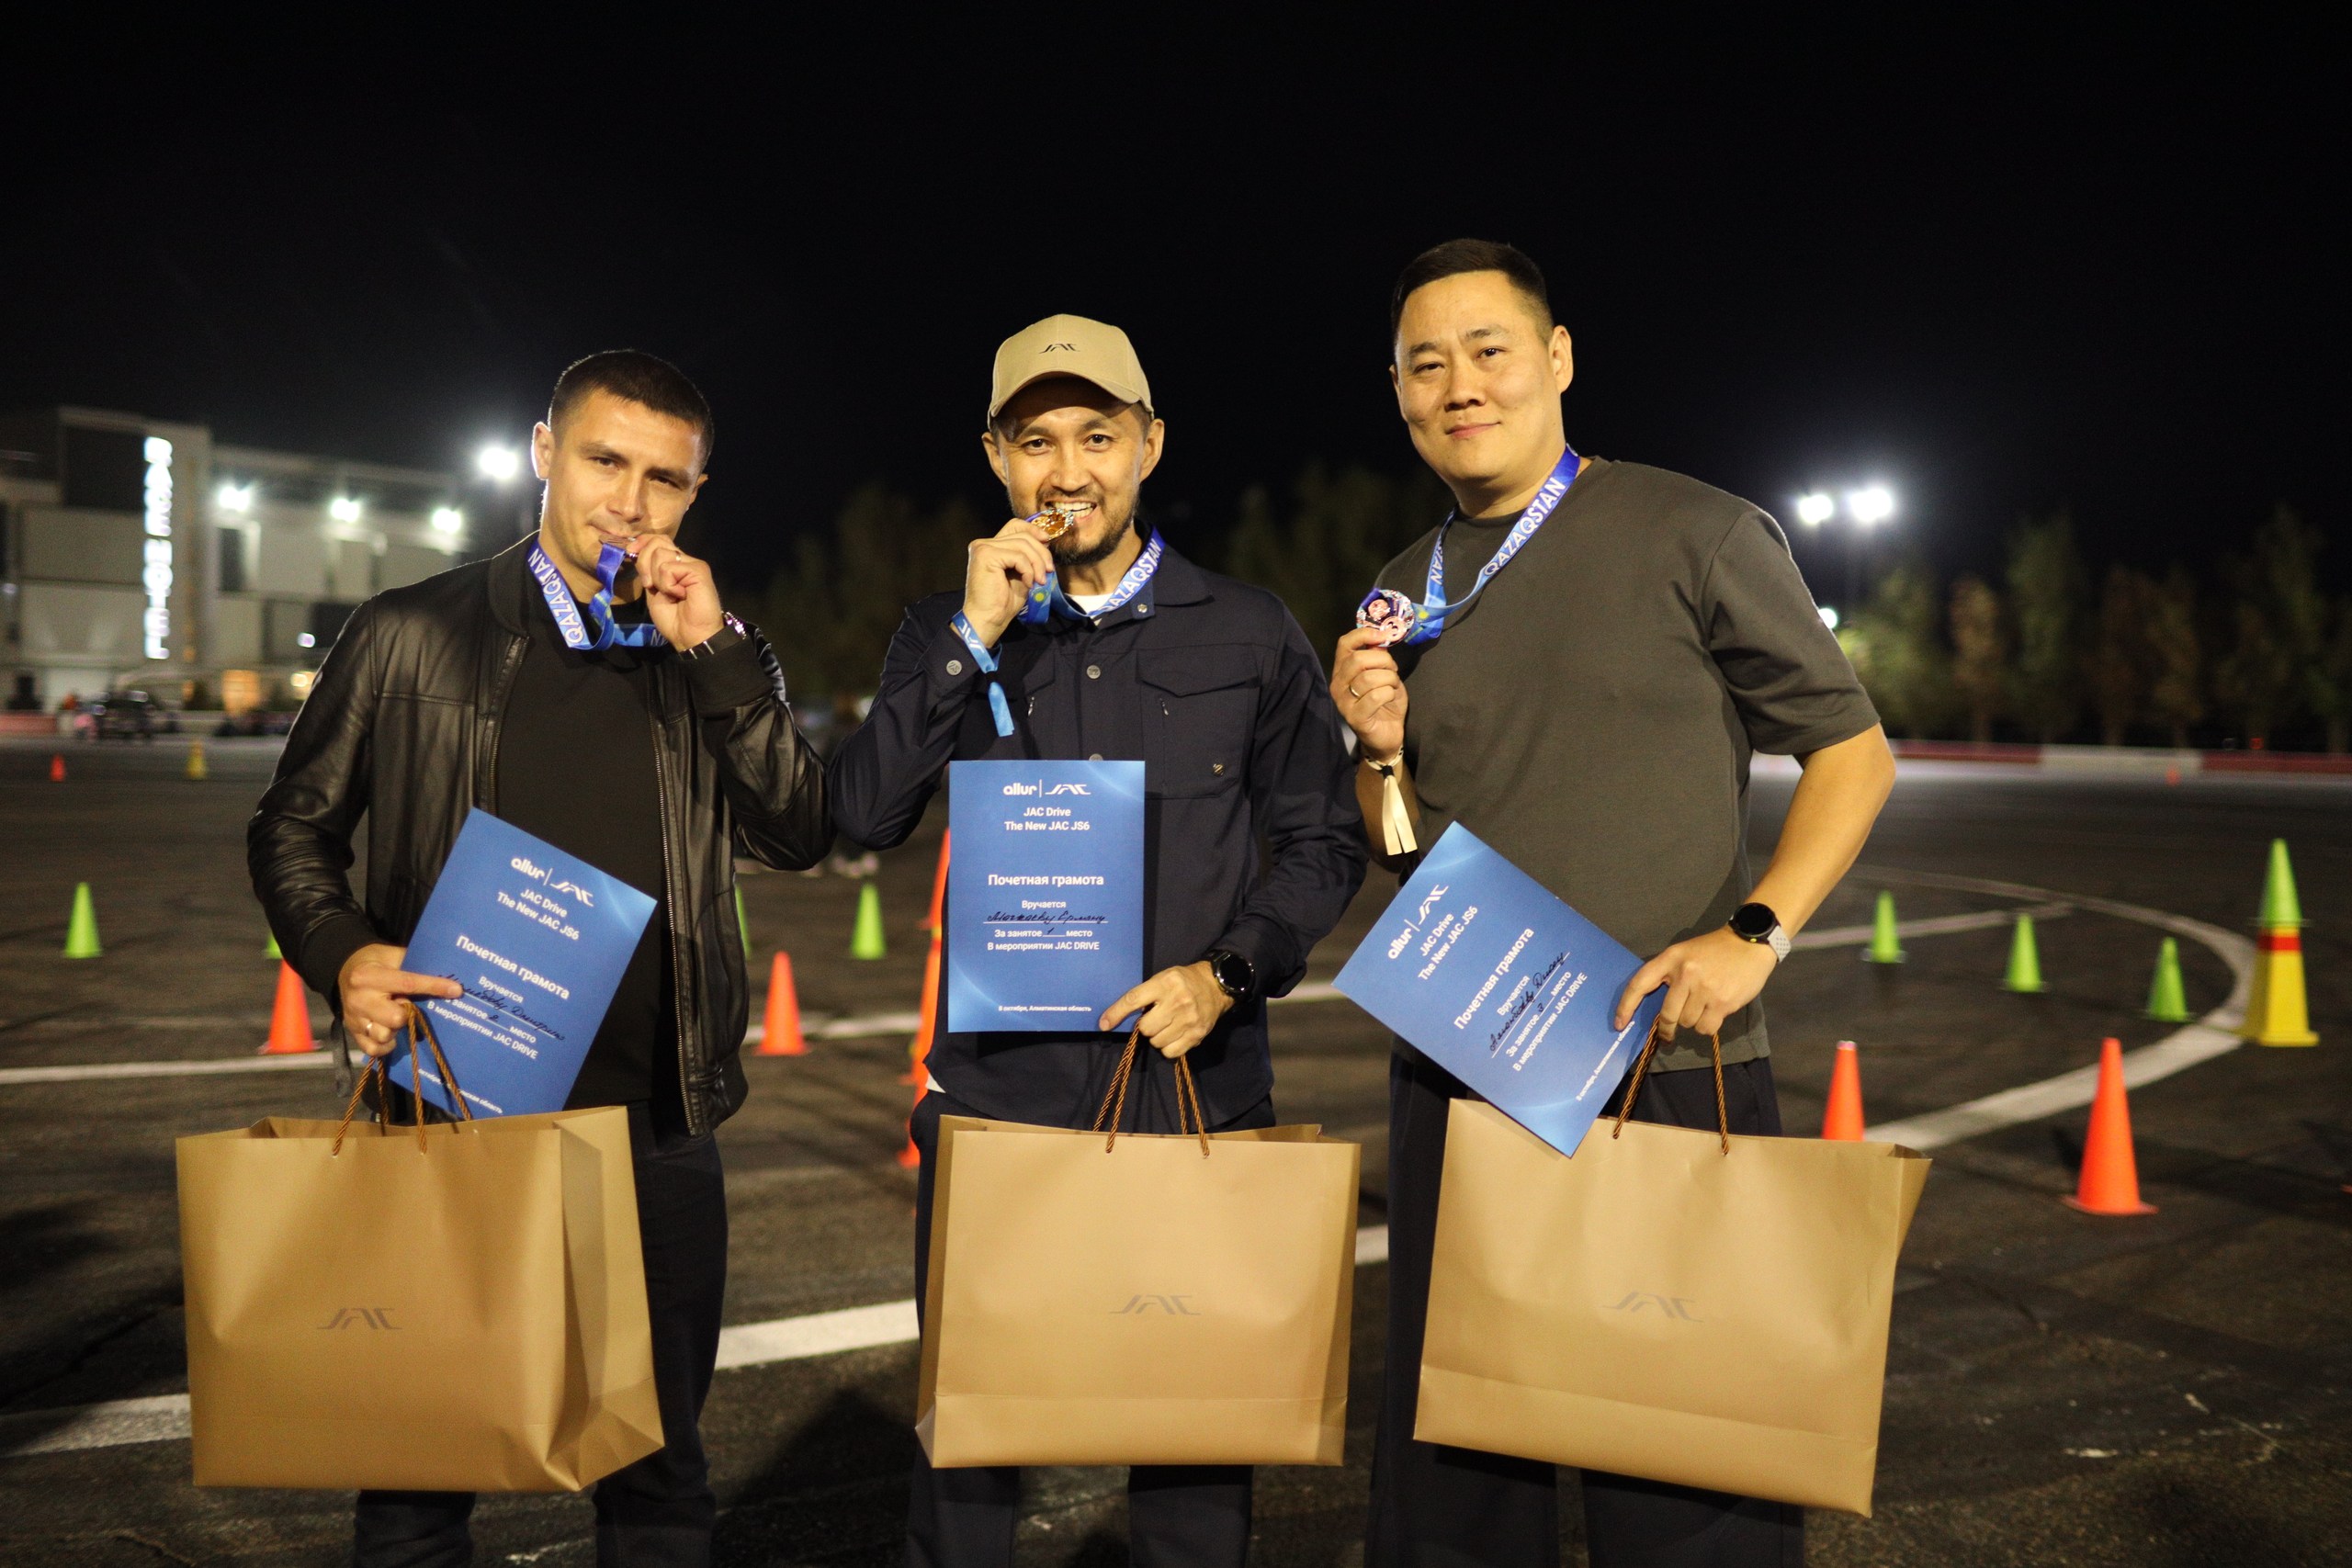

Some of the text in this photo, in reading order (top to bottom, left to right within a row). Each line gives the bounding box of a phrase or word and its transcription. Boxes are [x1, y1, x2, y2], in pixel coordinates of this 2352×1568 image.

[1484, 477, 1566, 576] QAZAQSTAN
[527, 548, 584, 644] QAZAQSTAN
[1002, 783, 1037, 795] allur
[1004, 820, 1091, 830] The New JAC JS6
[1023, 807, 1071, 817] JAC Drive
[511, 857, 545, 879] allur
[988, 874, 1104, 887] Почетная грамота
[498, 891, 579, 940] The New JAC JS6
[520, 889, 567, 918] JAC Drive
[1022, 900, 1067, 910] Вручается
[987, 942, 1100, 952] В мероприятии JAC DRIVE
[994, 930, 1006, 938] За
[1388, 928, 1411, 959] allur
[1419, 907, 1477, 979] The New JAC JS6
[1420, 914, 1453, 956] JAC Drive
[456, 935, 570, 999] Почетная грамота
[1454, 929, 1533, 1029] Почетная грамота
[479, 976, 524, 1003] Вручается
[1497, 976, 1530, 1015] Вручается
[1506, 1045, 1518, 1056] За
[1515, 1015, 1539, 1046] занятое
[1551, 972, 1571, 996] место
[1512, 973, 1587, 1071] В мероприятии JAC DRIVE
[427, 1001, 537, 1059] В мероприятии JAC DRIVE
[509, 1026, 536, 1043] место
